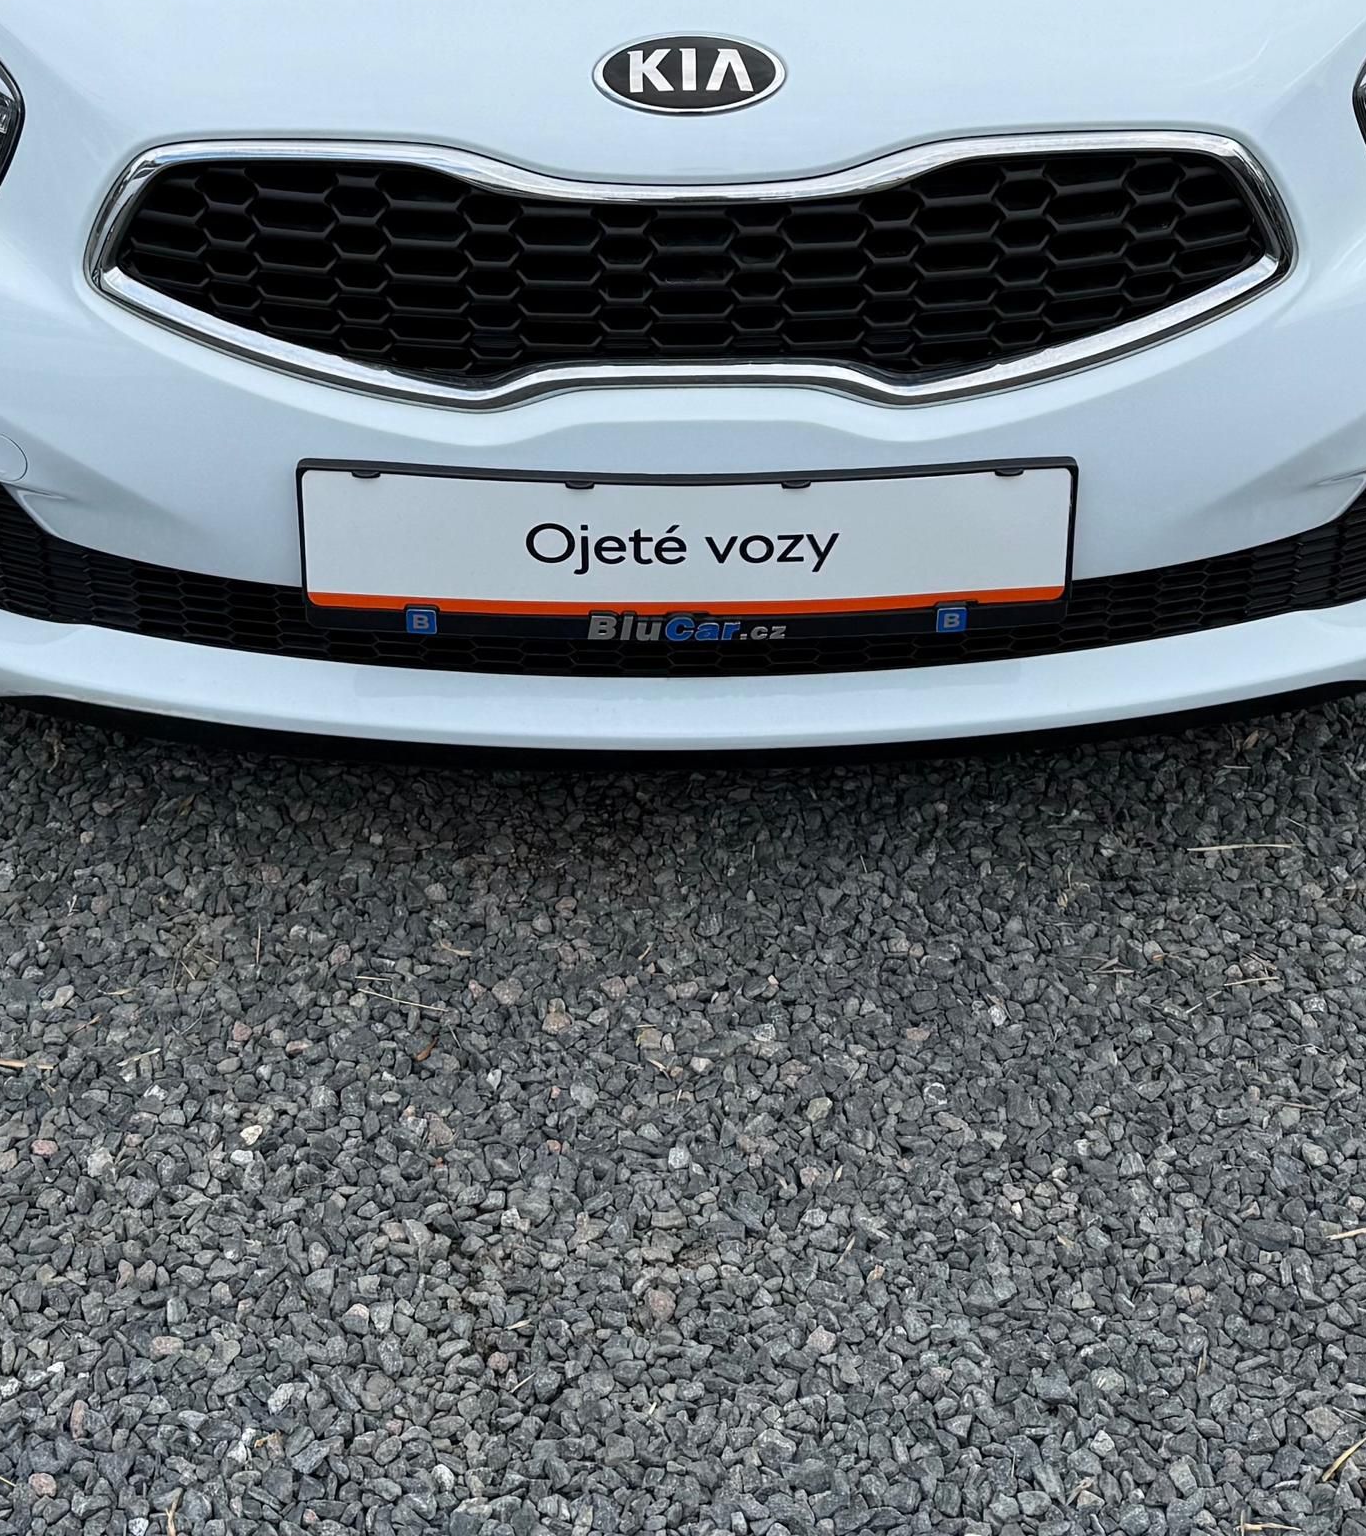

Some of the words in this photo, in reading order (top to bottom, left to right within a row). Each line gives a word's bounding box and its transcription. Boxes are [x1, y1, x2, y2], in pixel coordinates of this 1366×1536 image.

[627, 47, 754, 93] KIA
[525, 522, 687, 575] Ojeté
[704, 532, 840, 573] vozy
[413, 614, 429, 629] B
[587, 614, 787, 641] BluCar.cz
[944, 613, 960, 628] B
